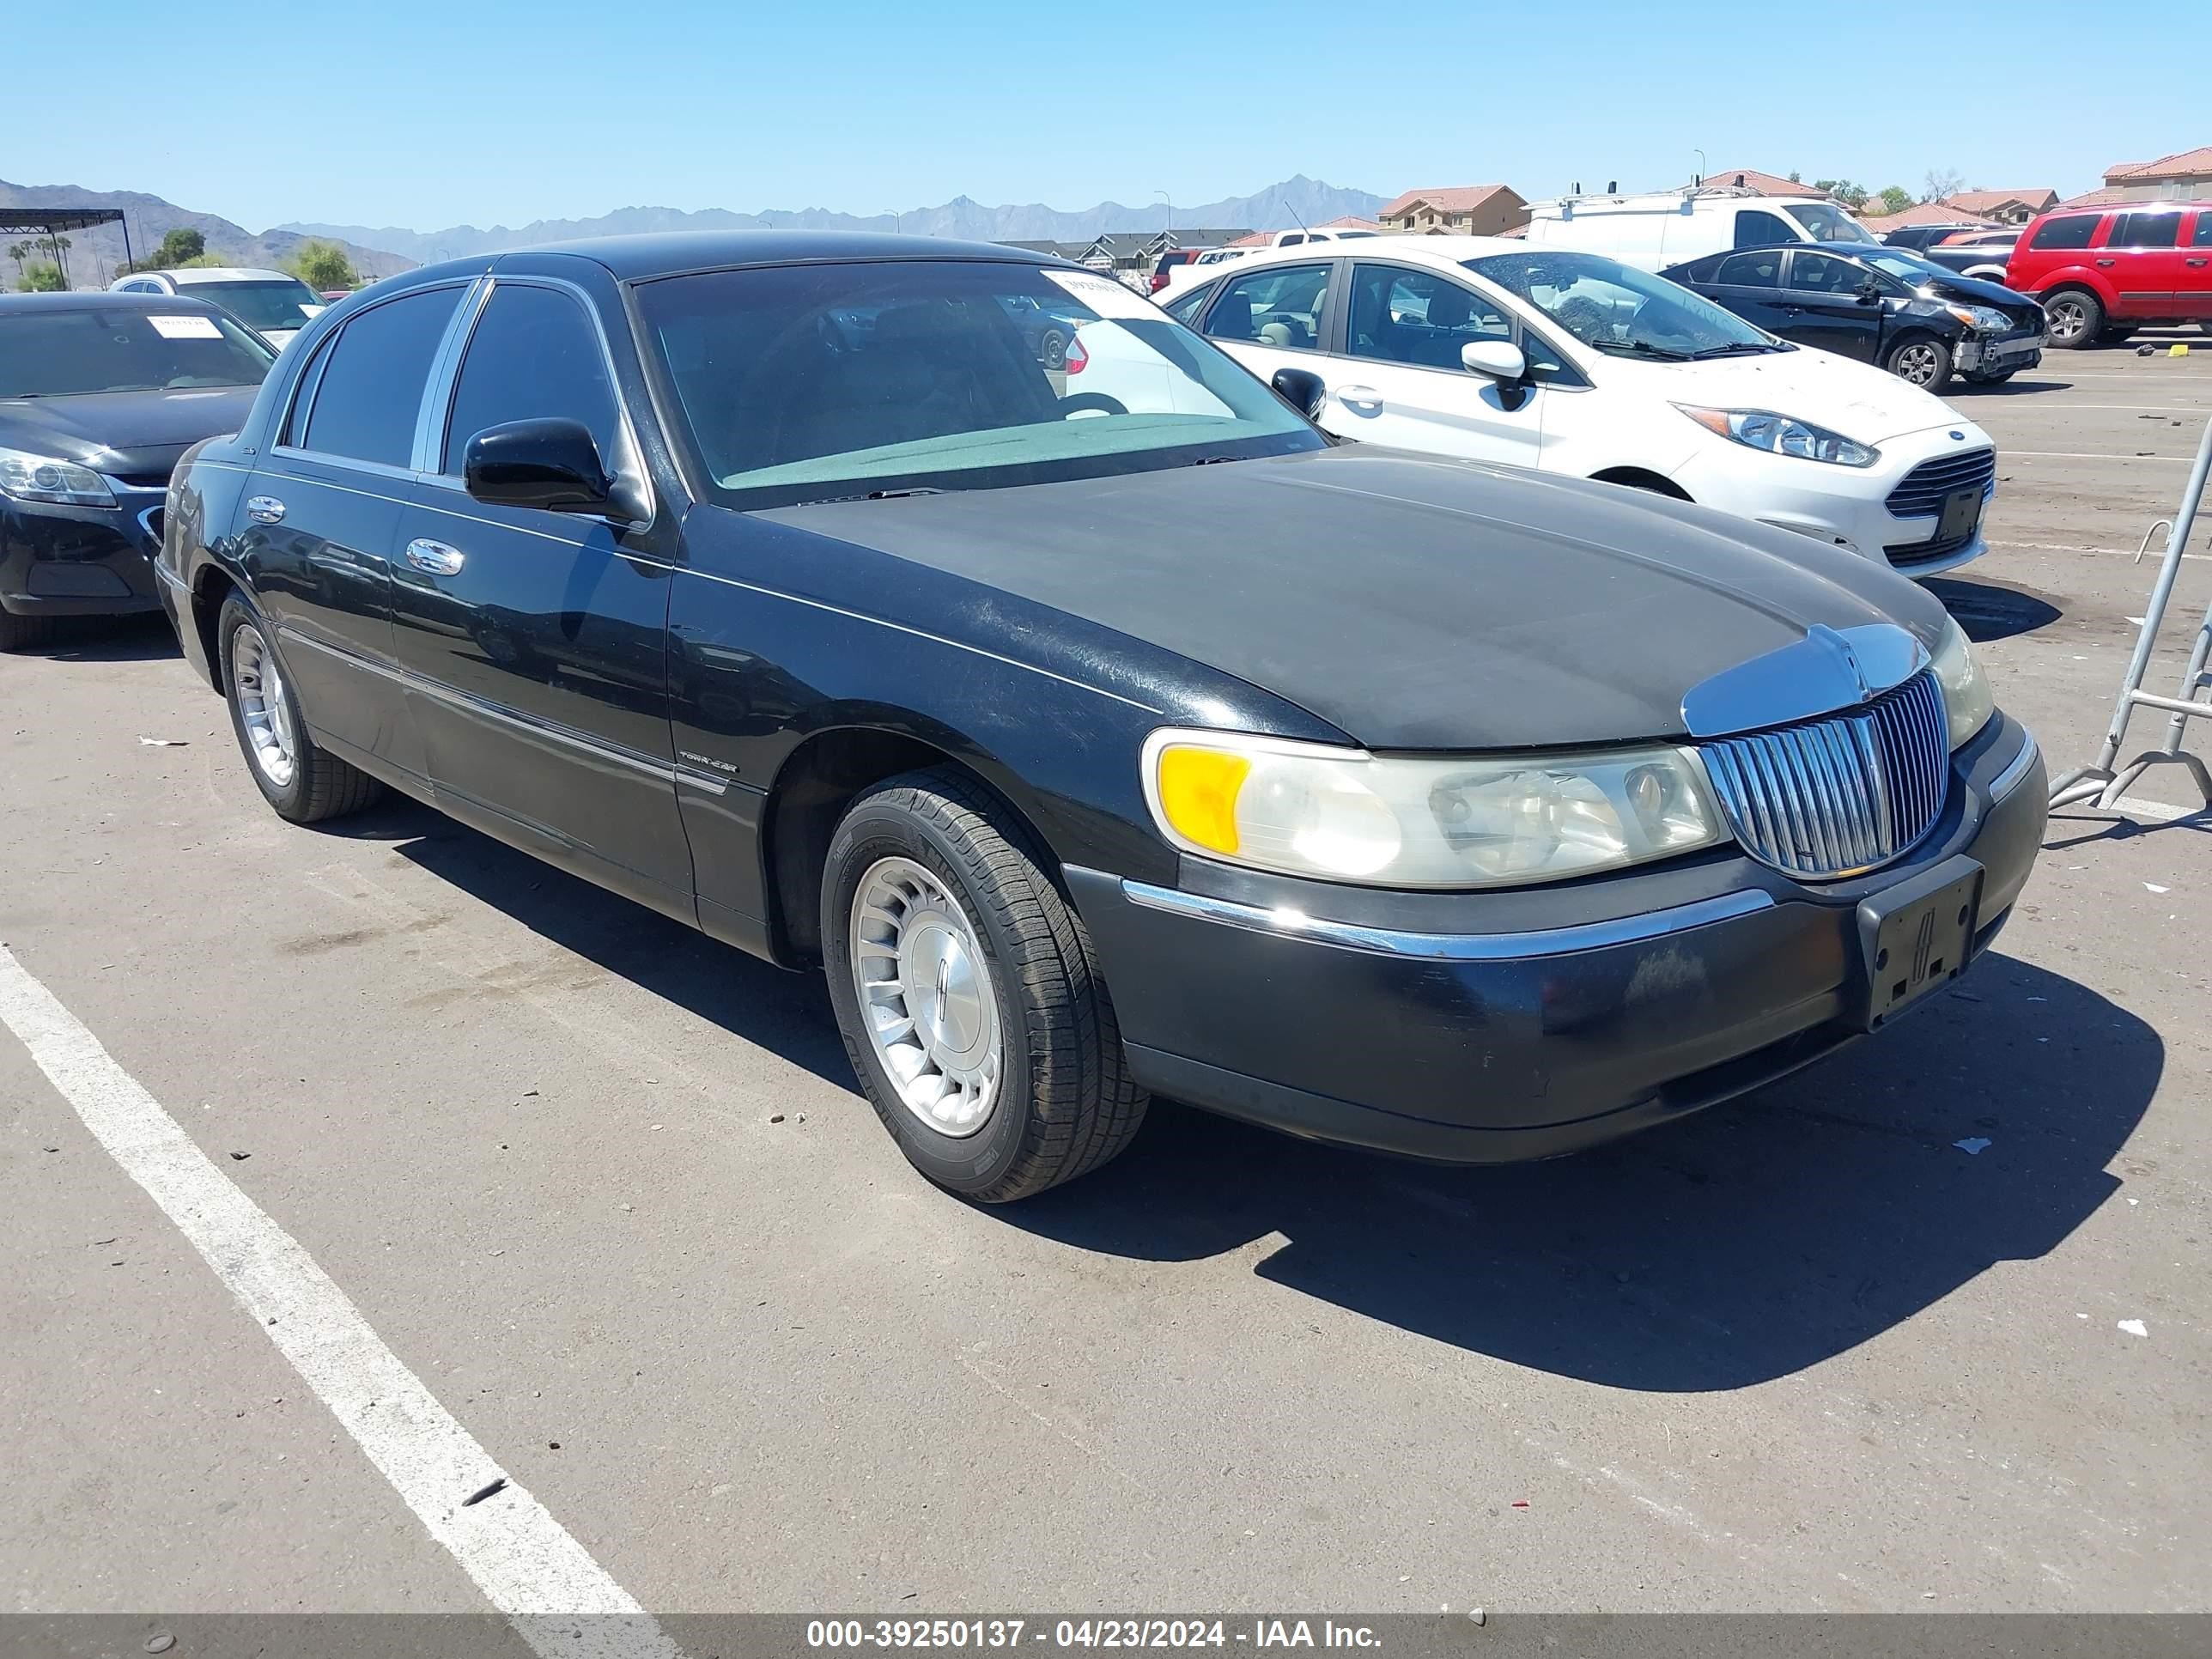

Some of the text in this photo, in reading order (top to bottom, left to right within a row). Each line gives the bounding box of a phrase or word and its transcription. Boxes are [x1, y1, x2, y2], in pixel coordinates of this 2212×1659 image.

[679, 750, 738, 773] TOWN CAR
[926, 848, 995, 954] MICHELIN
